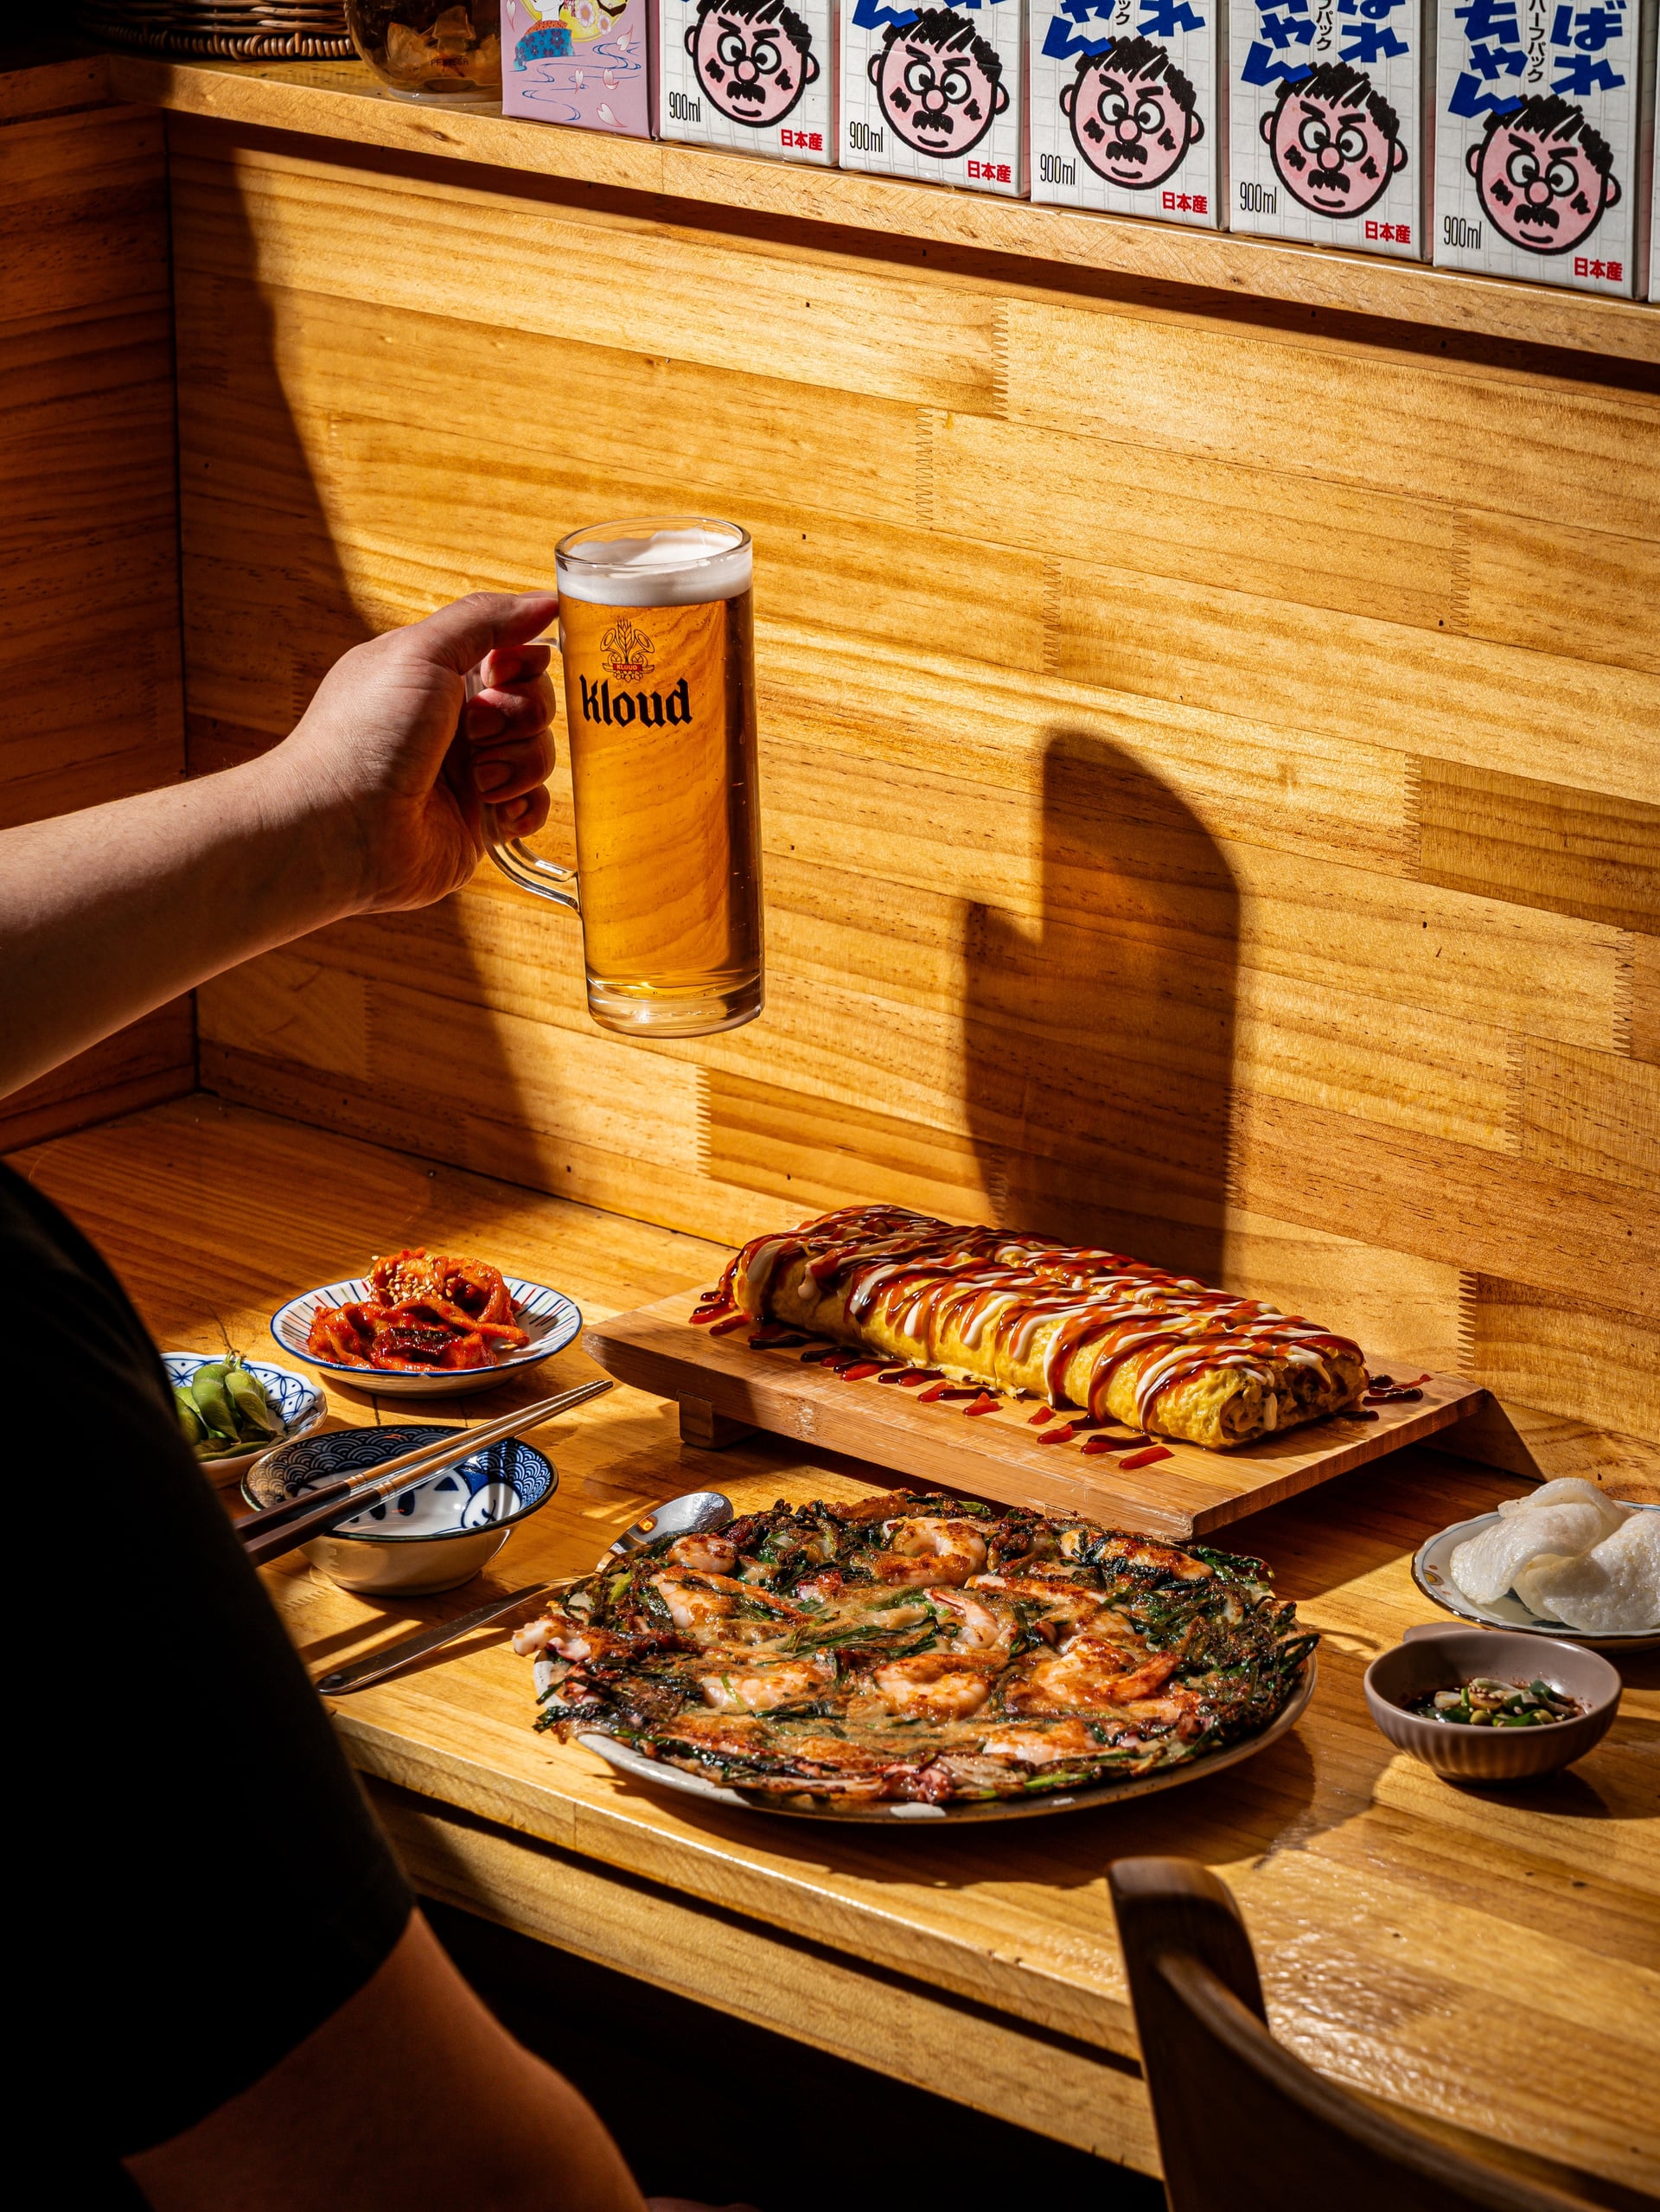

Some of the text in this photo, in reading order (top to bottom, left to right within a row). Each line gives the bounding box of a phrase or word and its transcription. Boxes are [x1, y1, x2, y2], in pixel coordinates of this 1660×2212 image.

[1241, 0, 1318, 86] ゃん
[1527, 0, 1547, 84] ハーフパック
[1549, 0, 1627, 96] ばれ
[1447, 0, 1529, 118] ちゃん
[668, 91, 701, 123] 900ml
[780, 128, 823, 151] 日本産
[849, 121, 884, 153] 900ml
[967, 159, 1012, 184] 日本産
[1039, 153, 1076, 186] 900ml
[1162, 190, 1208, 214] 日本産
[1239, 181, 1277, 214] 900ml
[1364, 220, 1411, 245] 日本産
[1443, 215, 1482, 250] 900ml
[1574, 257, 1623, 282] 日本産
